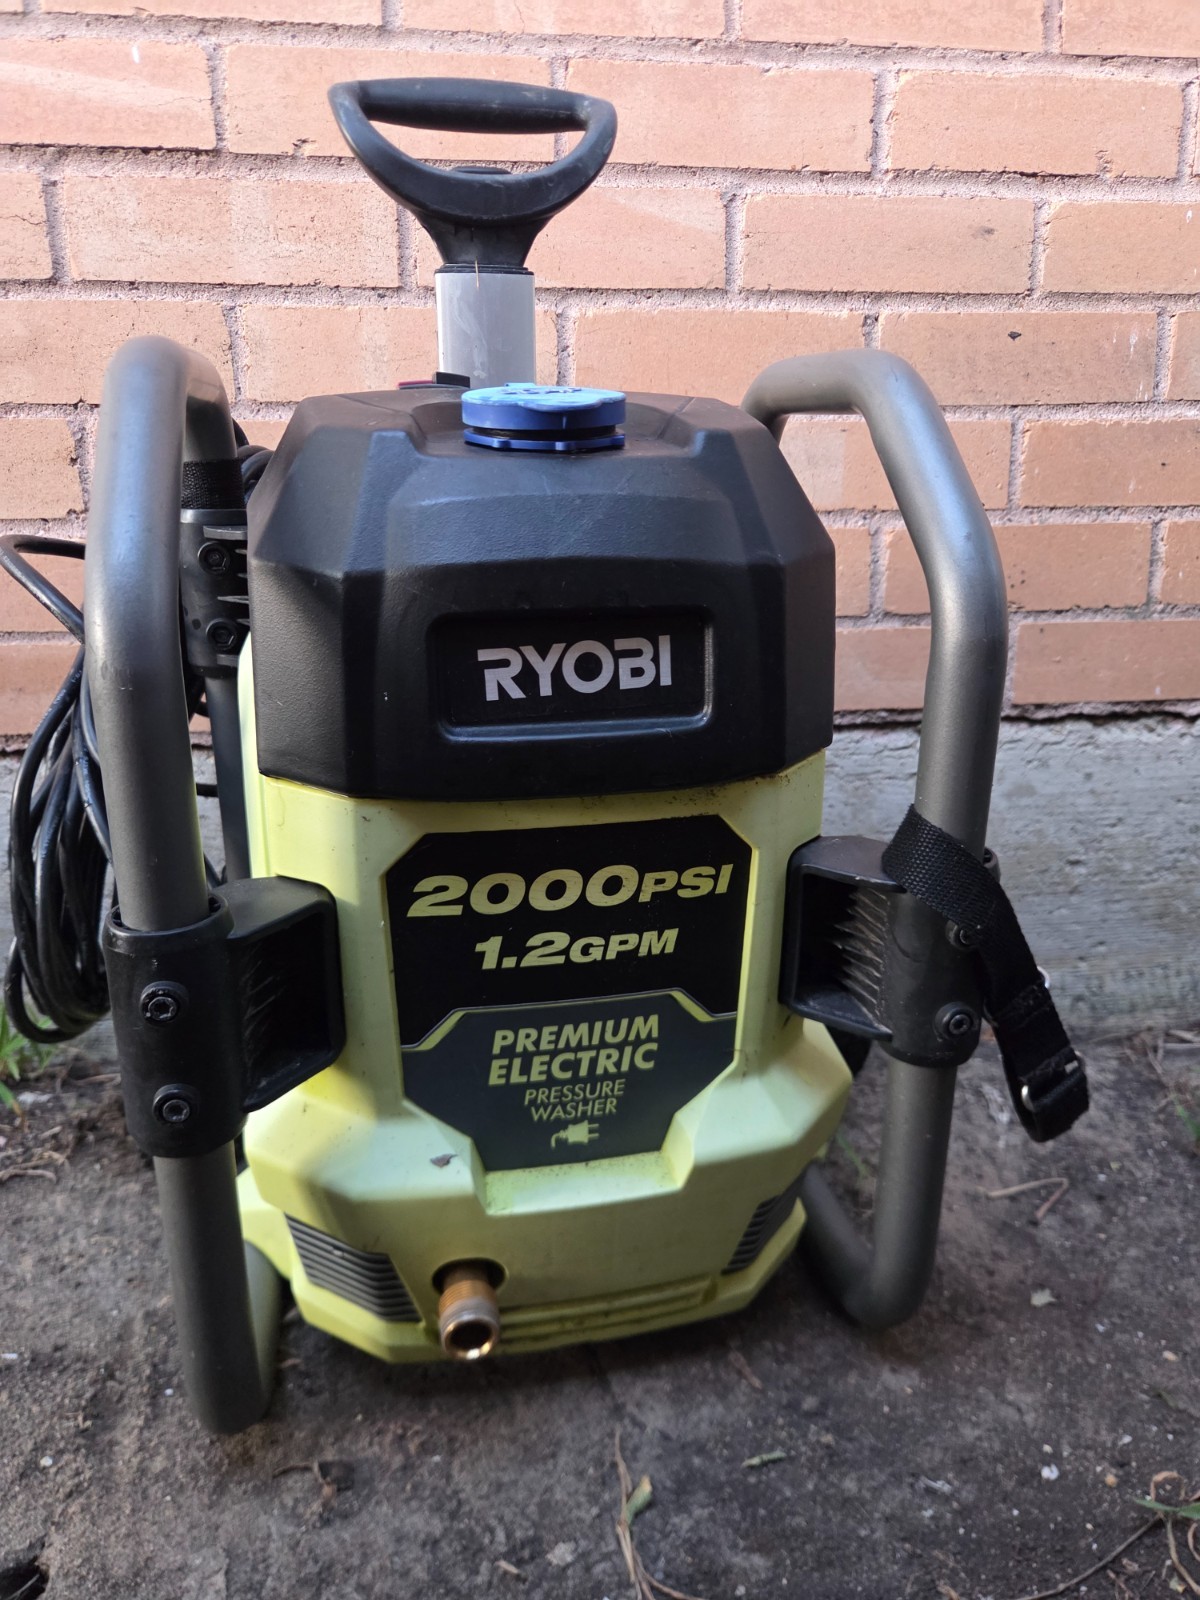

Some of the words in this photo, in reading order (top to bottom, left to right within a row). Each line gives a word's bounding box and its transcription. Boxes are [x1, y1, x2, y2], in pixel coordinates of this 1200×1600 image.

[477, 635, 672, 701] RYOBI
[492, 1014, 659, 1055] PREMIUM
[488, 1042, 658, 1086] ELECTRIC
[524, 1078, 625, 1105] PRESSURE
[531, 1098, 617, 1122] WASHER
